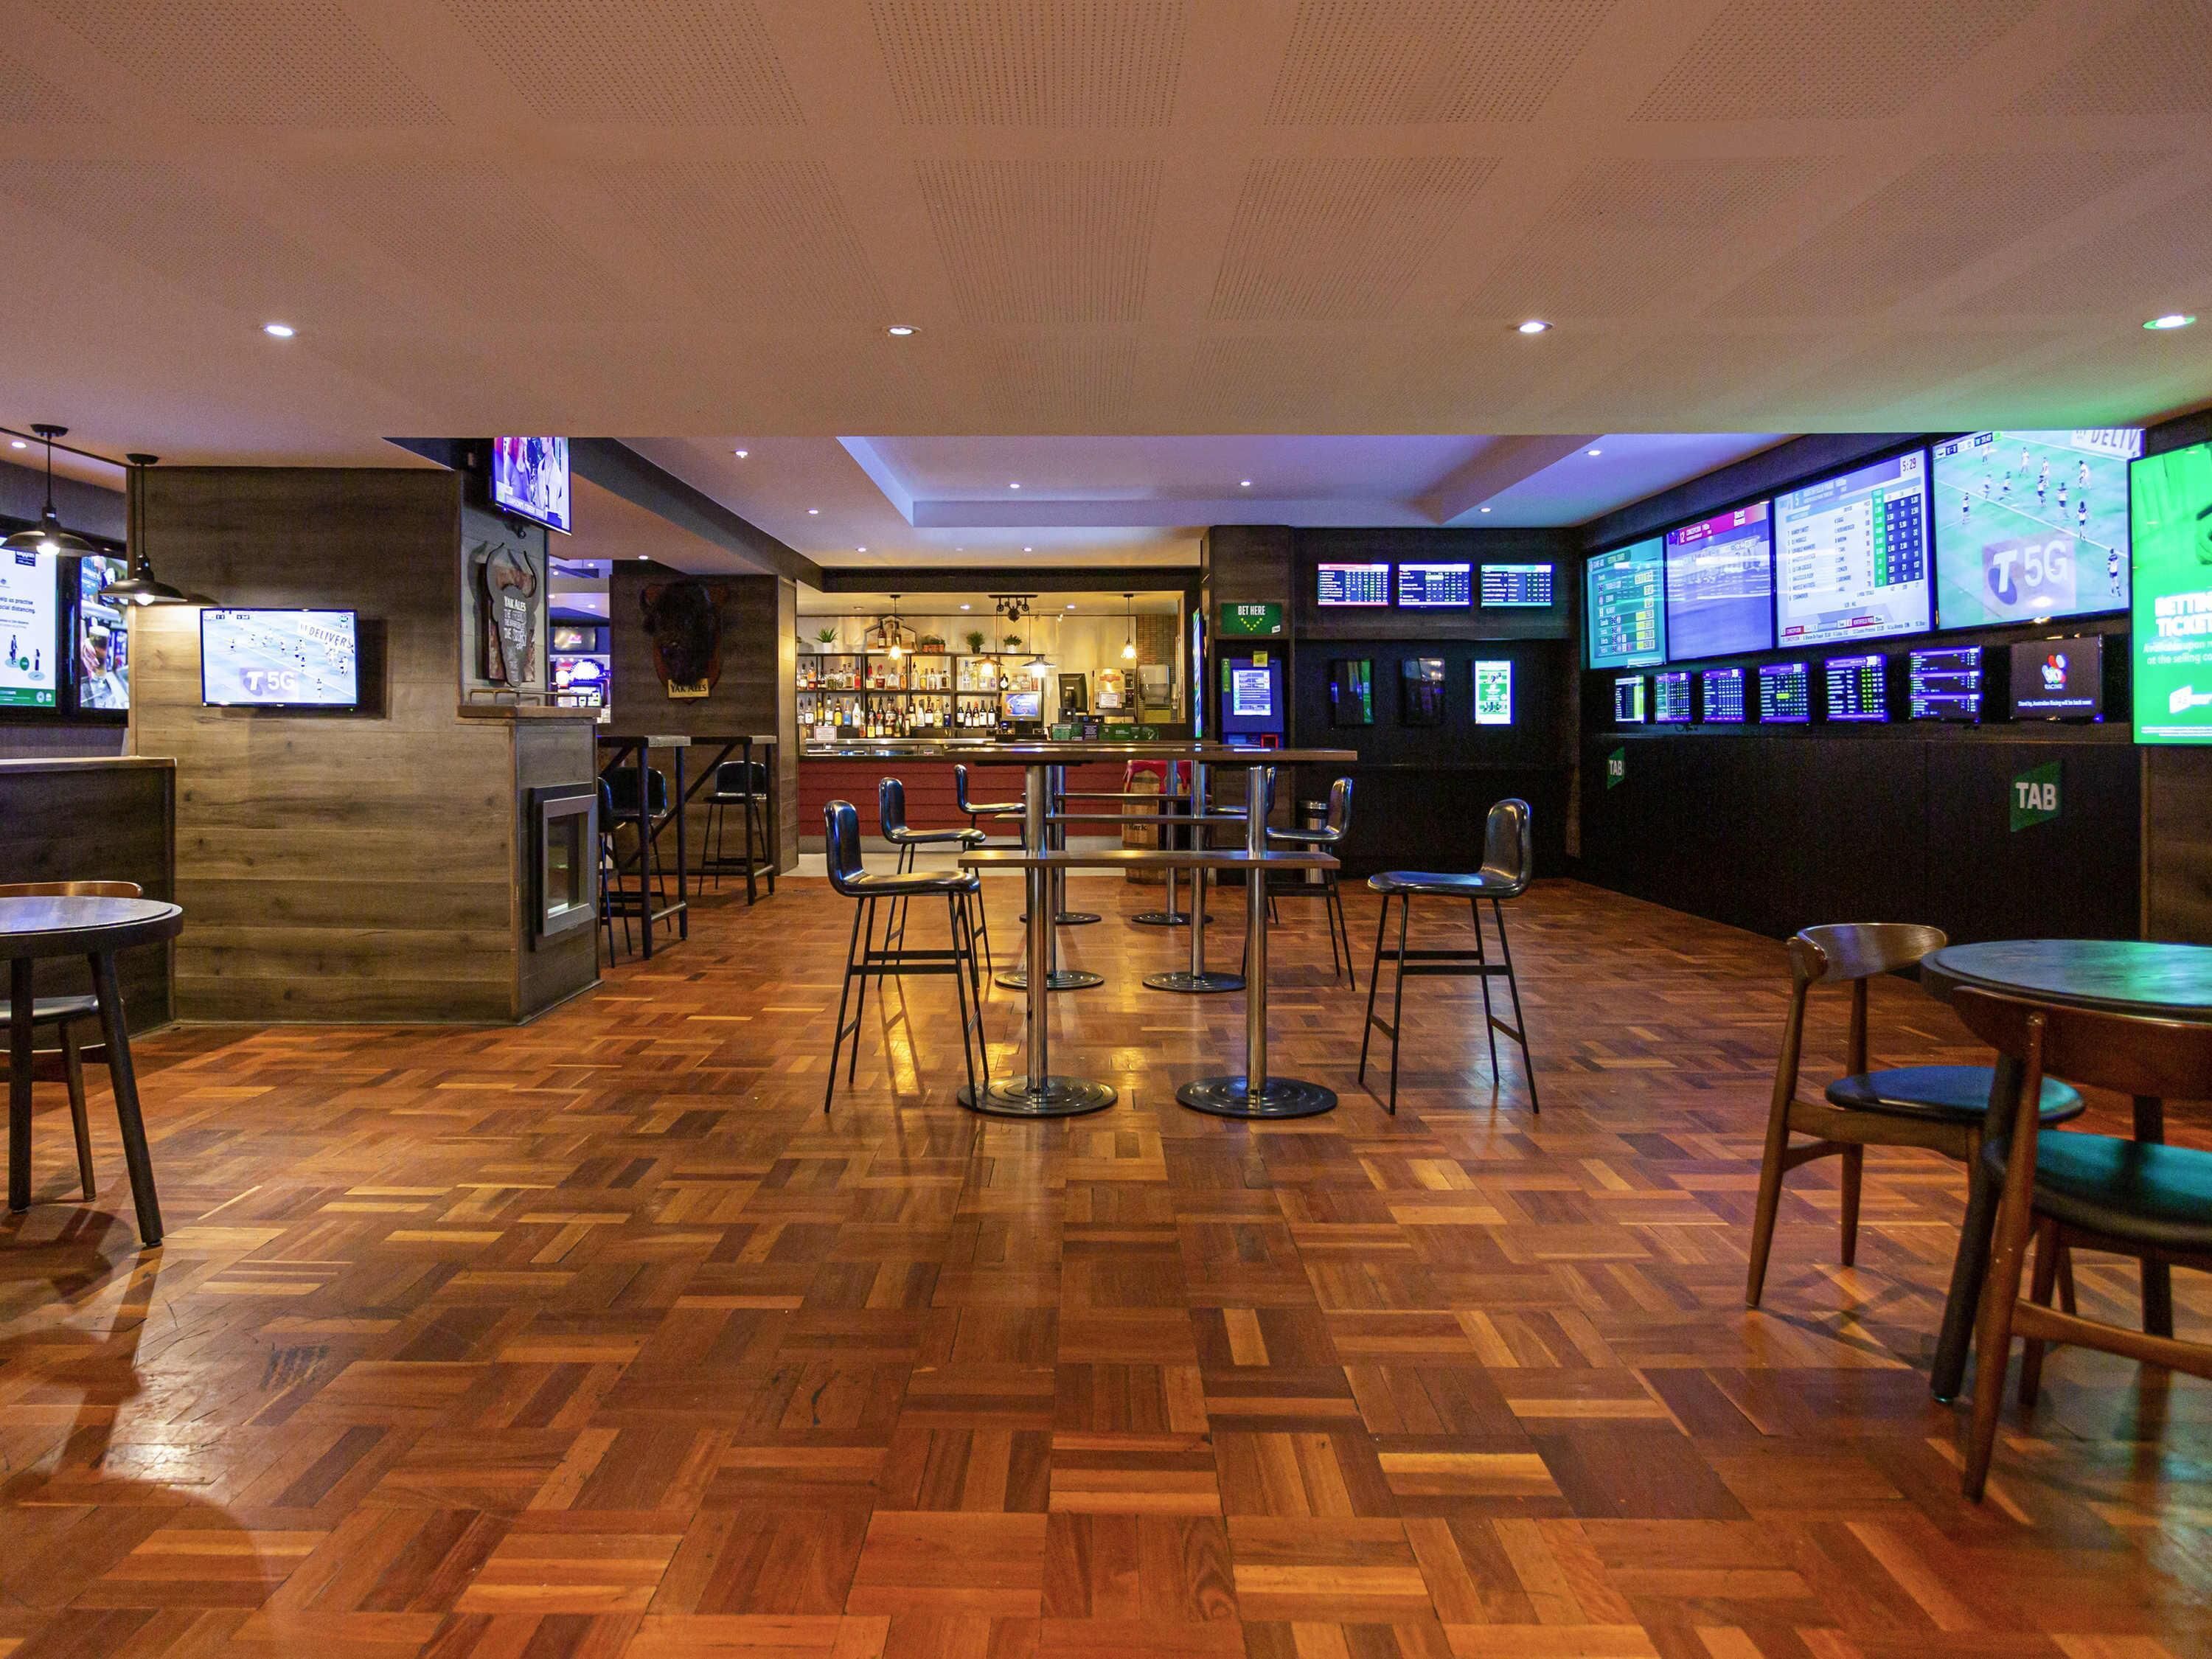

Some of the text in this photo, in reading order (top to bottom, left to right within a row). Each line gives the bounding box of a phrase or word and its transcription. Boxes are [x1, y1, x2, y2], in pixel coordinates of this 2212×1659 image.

[2091, 429, 2138, 451] DELIV
[1902, 458, 1916, 472] 5:29
[2024, 540, 2068, 588] 5G
[1238, 605, 1265, 615] BET HERE
[267, 671, 295, 691] 5G
[670, 684, 686, 693] YAK
[1609, 760, 1623, 776] TAB
[2015, 782, 2056, 811] TAB
